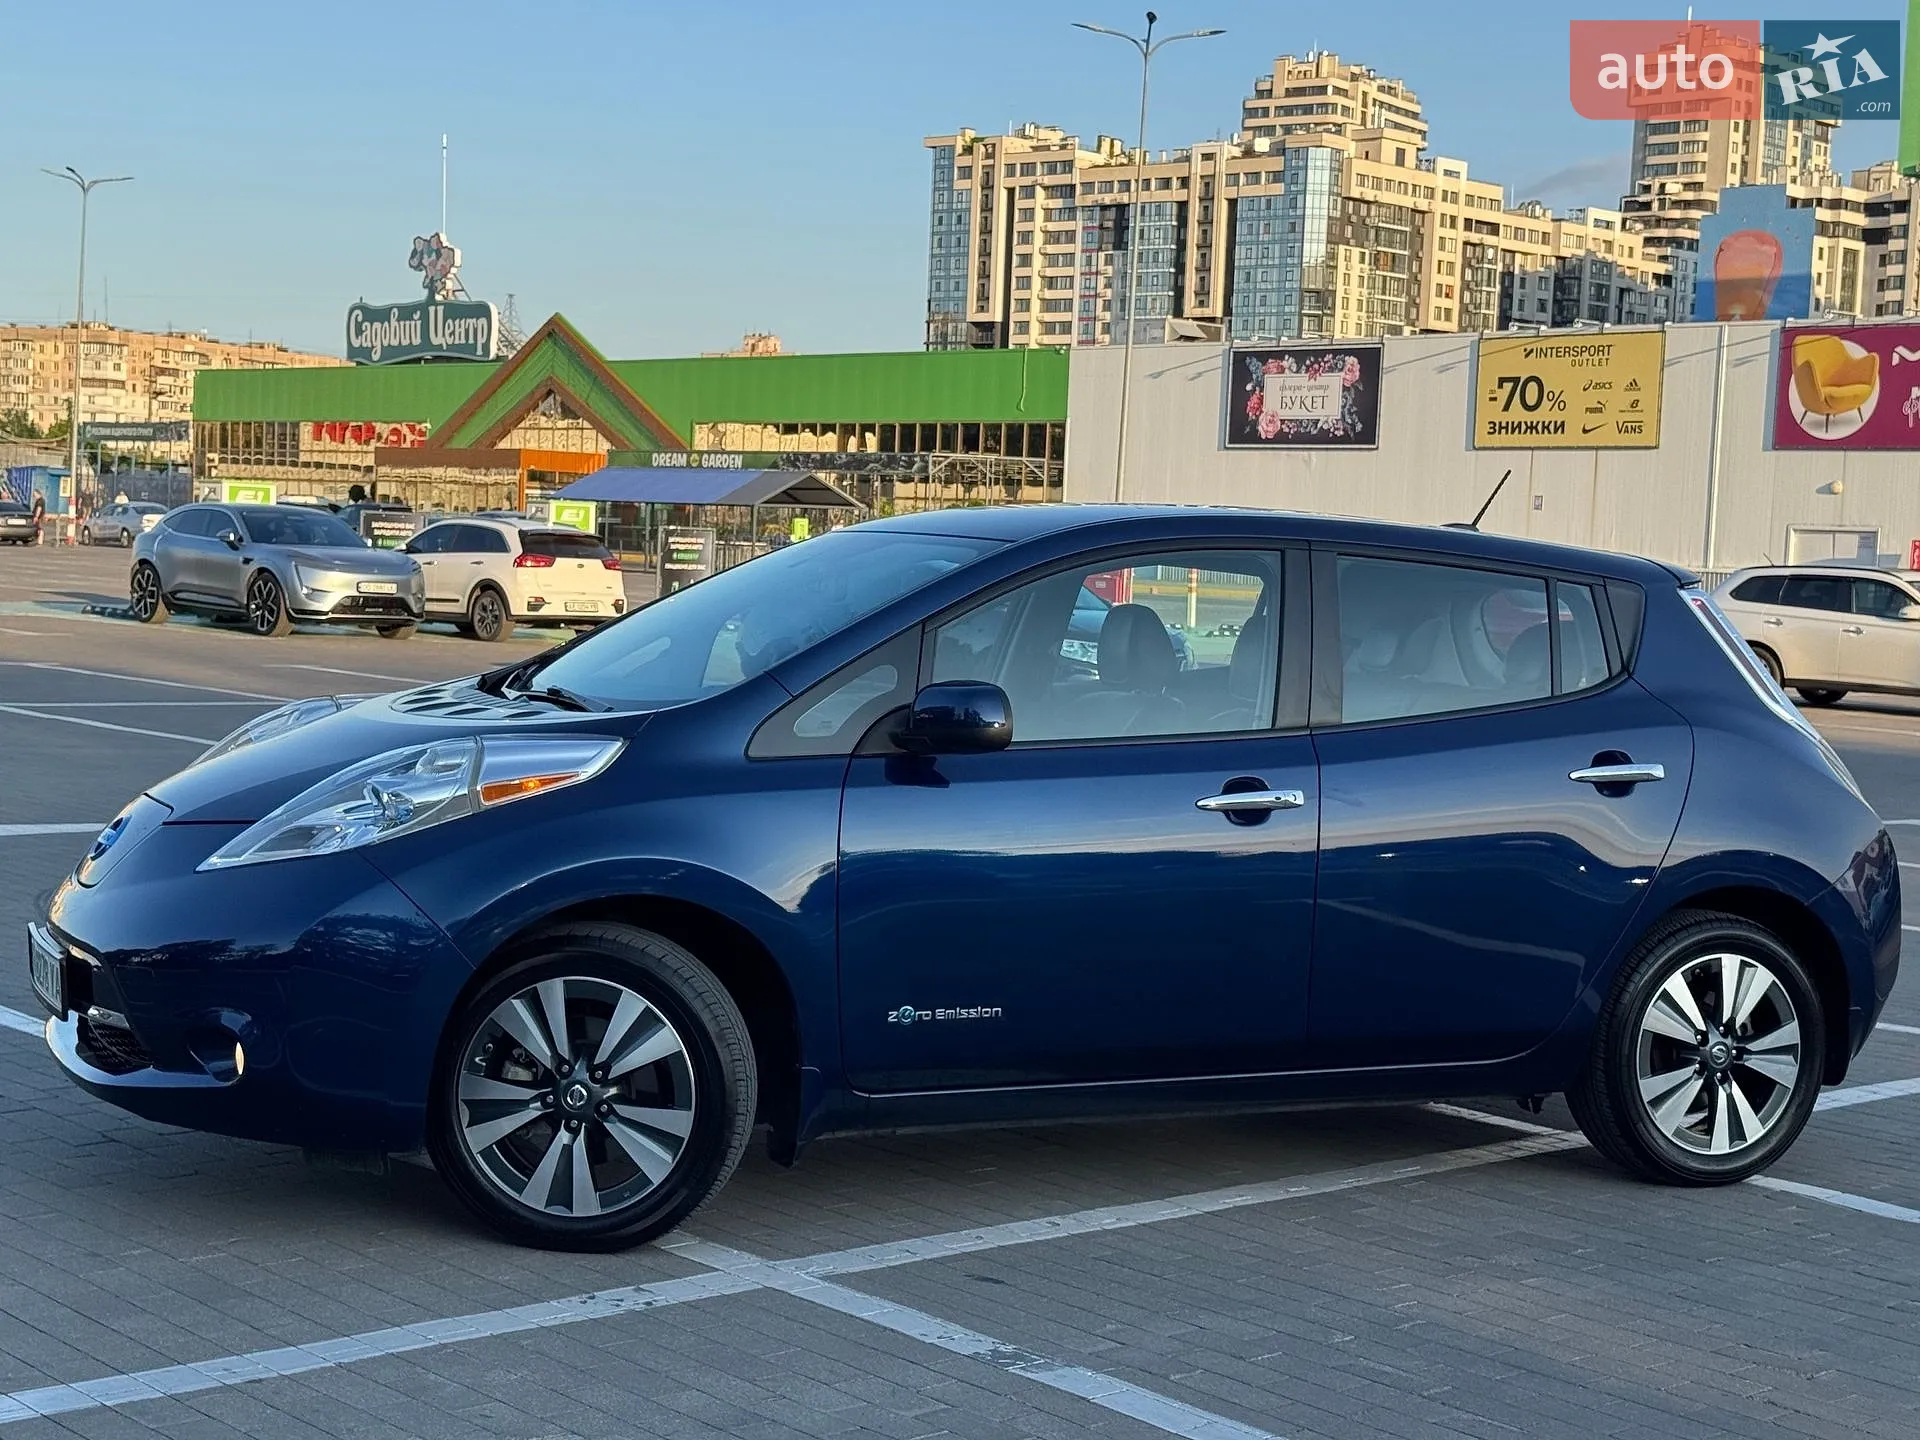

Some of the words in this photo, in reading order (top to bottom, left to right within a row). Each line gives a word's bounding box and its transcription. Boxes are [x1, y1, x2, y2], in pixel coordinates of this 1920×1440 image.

[350, 307, 422, 362] Садовий
[428, 305, 488, 356] Центр
[1535, 344, 1613, 359] INTERSPORT
[1570, 358, 1610, 368] OUTLET
[1280, 395, 1329, 413] БУКЕТ
[1487, 420, 1566, 436] ЗНИЖКИ
[1615, 420, 1644, 435] VANS
[652, 452, 688, 467] DREAM
[701, 453, 743, 468] GARDEN
[935, 1006, 1002, 1020] Emission
